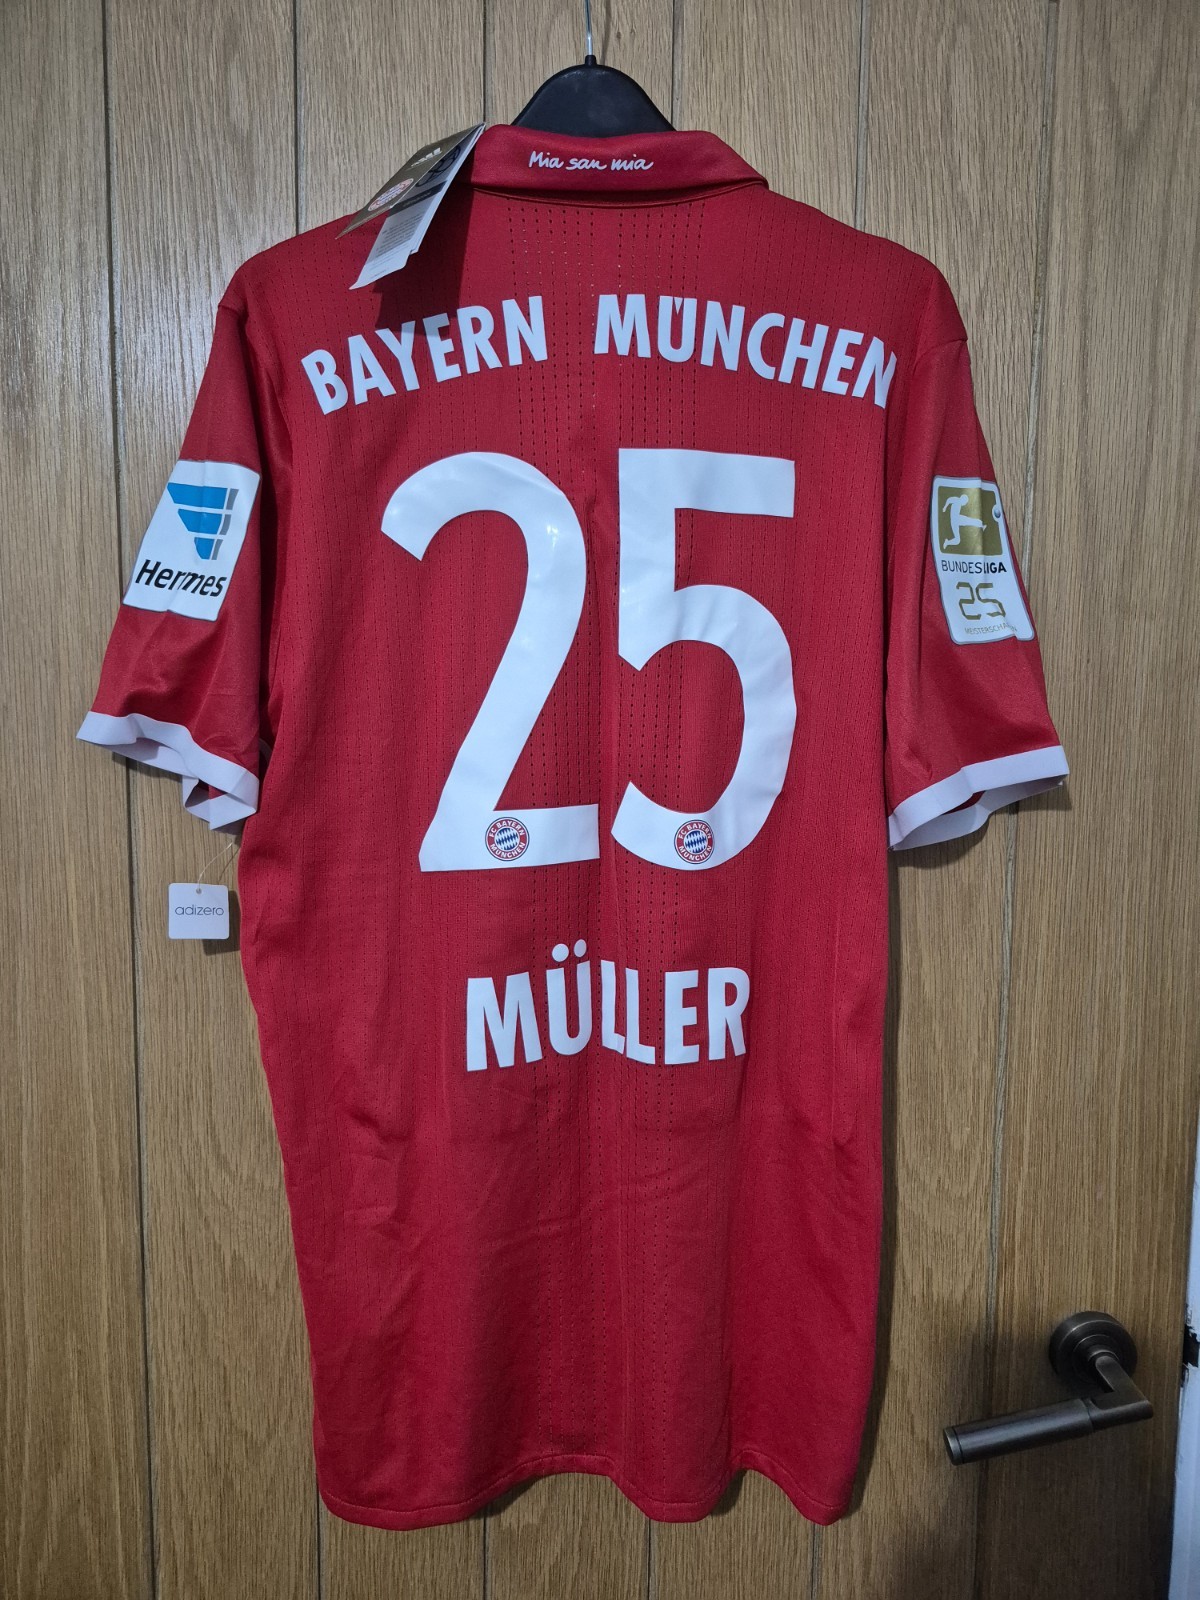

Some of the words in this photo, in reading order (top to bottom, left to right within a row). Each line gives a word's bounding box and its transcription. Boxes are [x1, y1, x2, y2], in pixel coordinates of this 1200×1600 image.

[528, 150, 564, 169] Mia
[566, 158, 606, 171] san
[610, 153, 654, 171] mia
[301, 296, 547, 414] BAYERN
[594, 293, 897, 409] MÜNCHEN
[135, 559, 227, 597] Hermes
[941, 559, 1007, 574] BUNDESLIGA
[956, 582, 1006, 621] 25
[381, 448, 796, 872] 25
[489, 827, 497, 838] FC
[496, 820, 525, 836] BAYERN
[678, 829, 687, 839] FC
[686, 823, 712, 839] BAYERN
[174, 904, 224, 916] adizero
[466, 940, 750, 1072] MÜLLER
